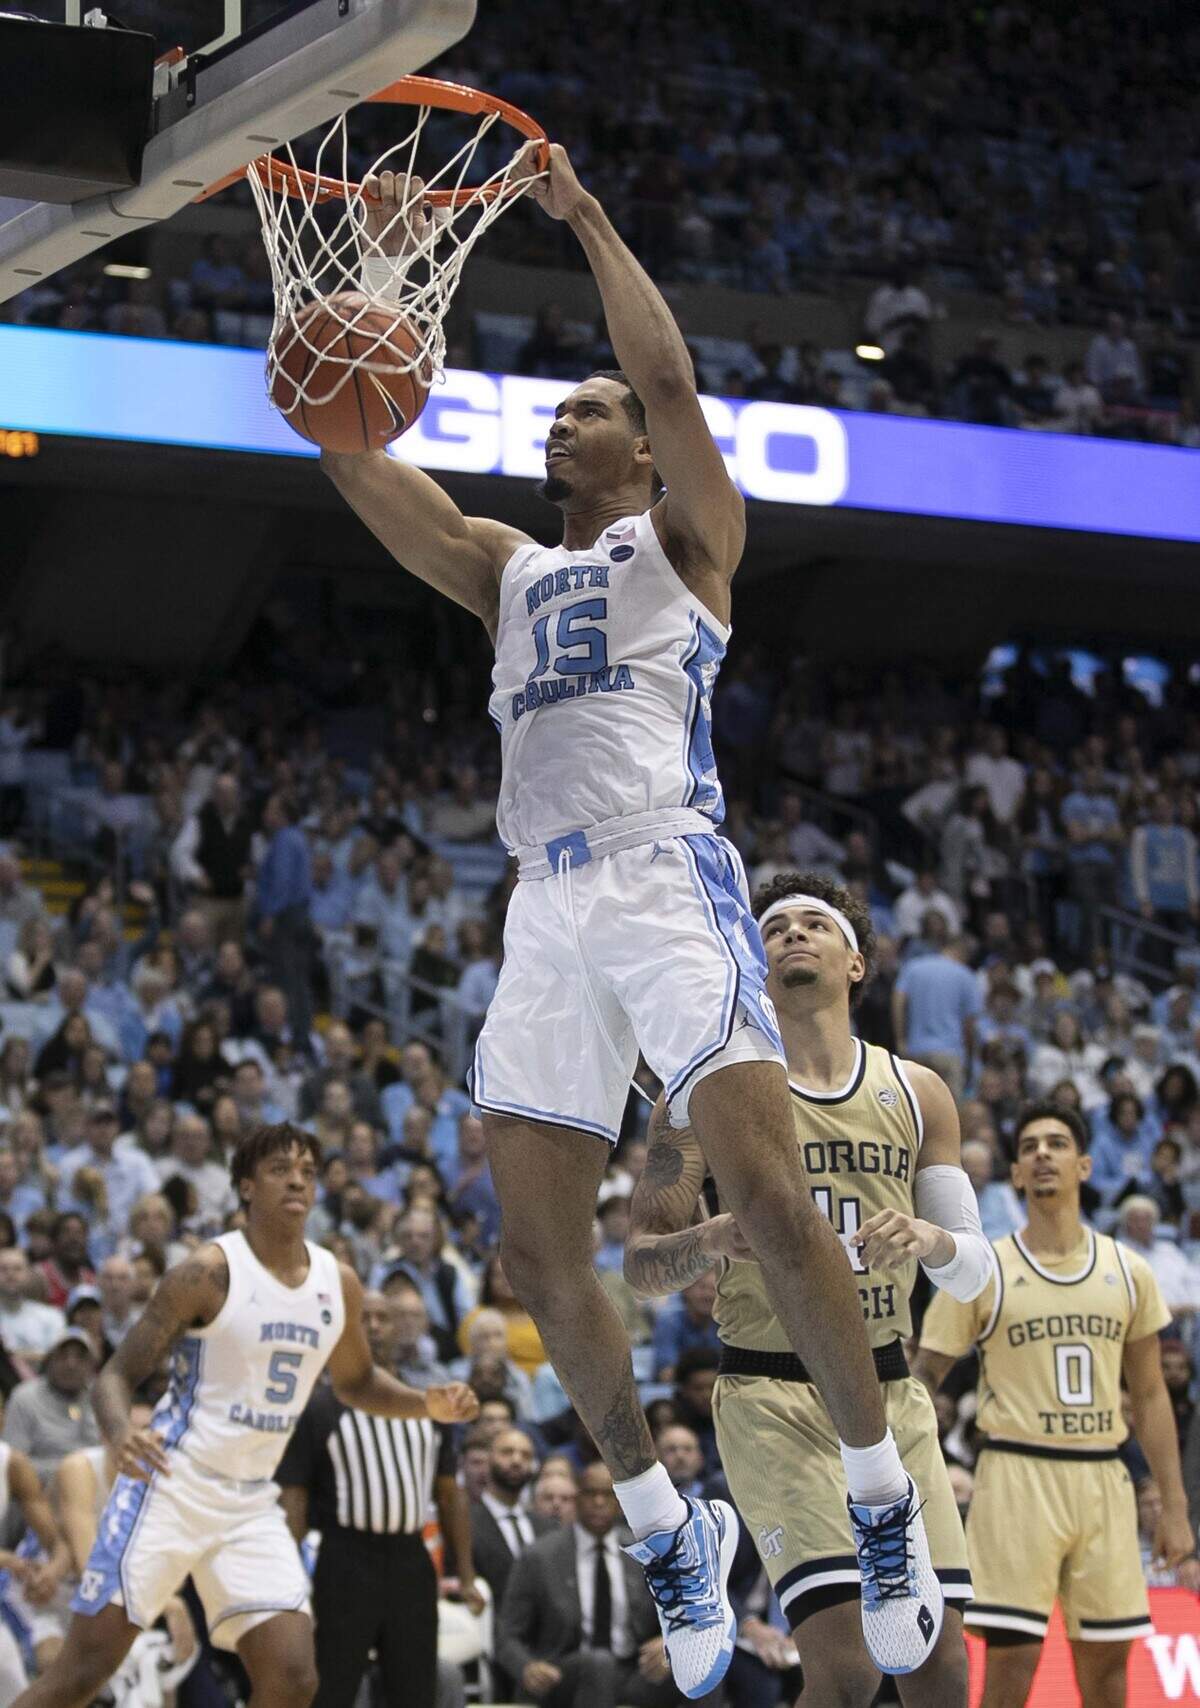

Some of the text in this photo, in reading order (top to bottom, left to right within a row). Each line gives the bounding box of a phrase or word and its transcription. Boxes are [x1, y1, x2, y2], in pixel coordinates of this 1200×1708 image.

[388, 368, 849, 506] GEO
[525, 565, 610, 617] NORTH
[527, 597, 609, 682] 15
[797, 1140, 909, 1182] ORGIA
[857, 1284, 896, 1320] CH
[259, 1322, 319, 1350] NORTH
[264, 1351, 302, 1405] 5
[1053, 1342, 1094, 1407] 0
[1038, 1410, 1113, 1434] TECH
